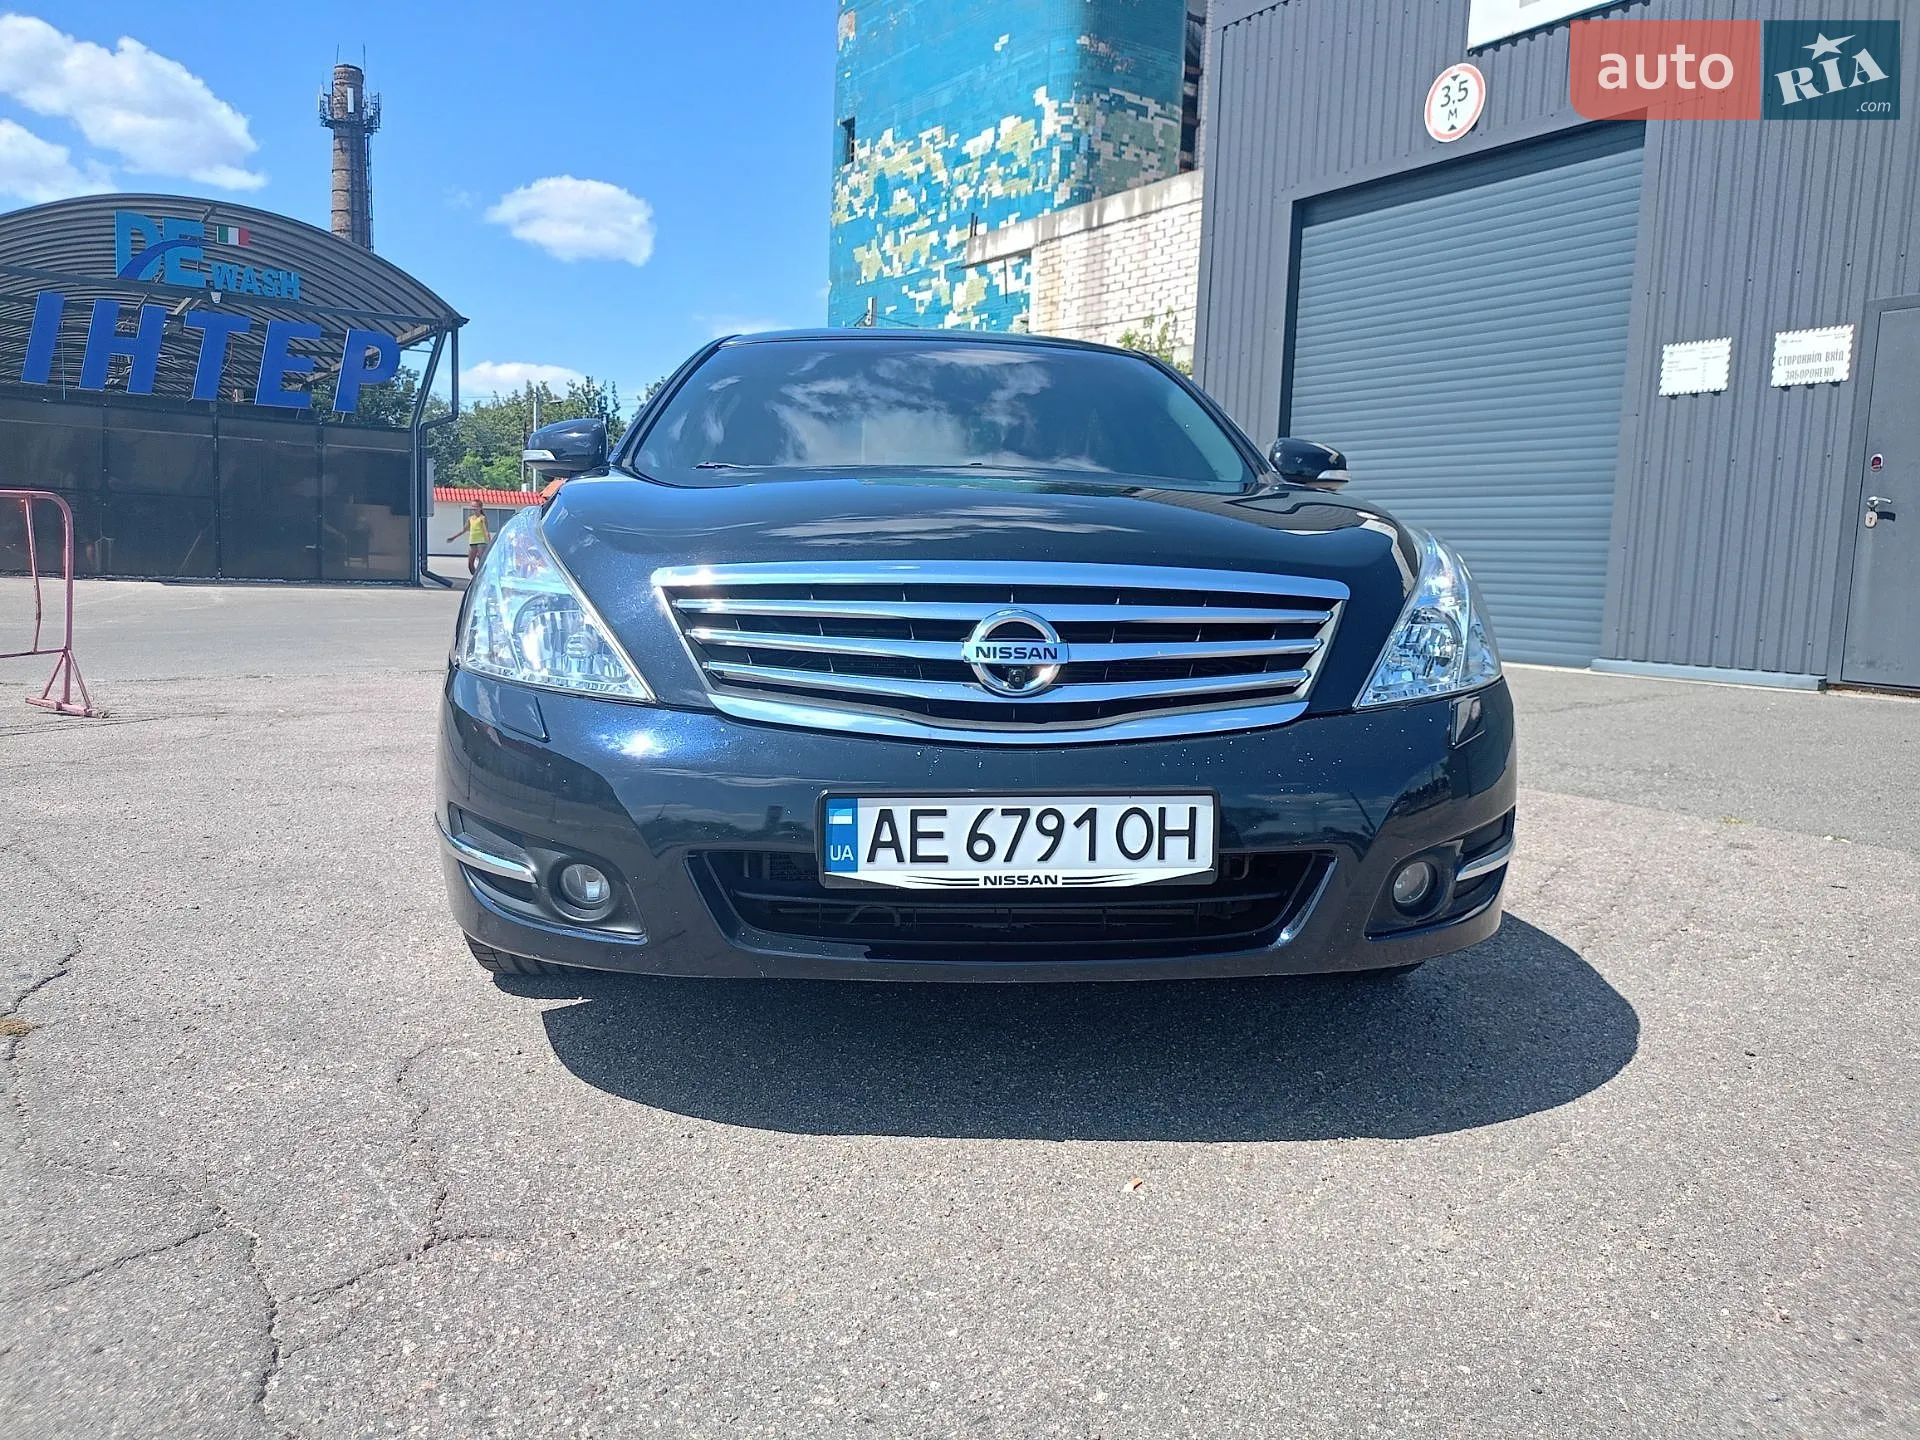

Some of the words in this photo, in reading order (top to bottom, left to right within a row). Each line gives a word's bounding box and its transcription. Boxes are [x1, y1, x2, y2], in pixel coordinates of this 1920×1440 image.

[115, 211, 205, 288] DE
[210, 263, 300, 300] WASH
[20, 290, 401, 413] ІНТЕР
[975, 646, 1058, 660] NISSAN
[829, 845, 855, 861] UA
[866, 808, 949, 864] AE
[966, 807, 1098, 863] 6791
[1115, 805, 1197, 861] OH
[983, 874, 1058, 886] NISSAN
